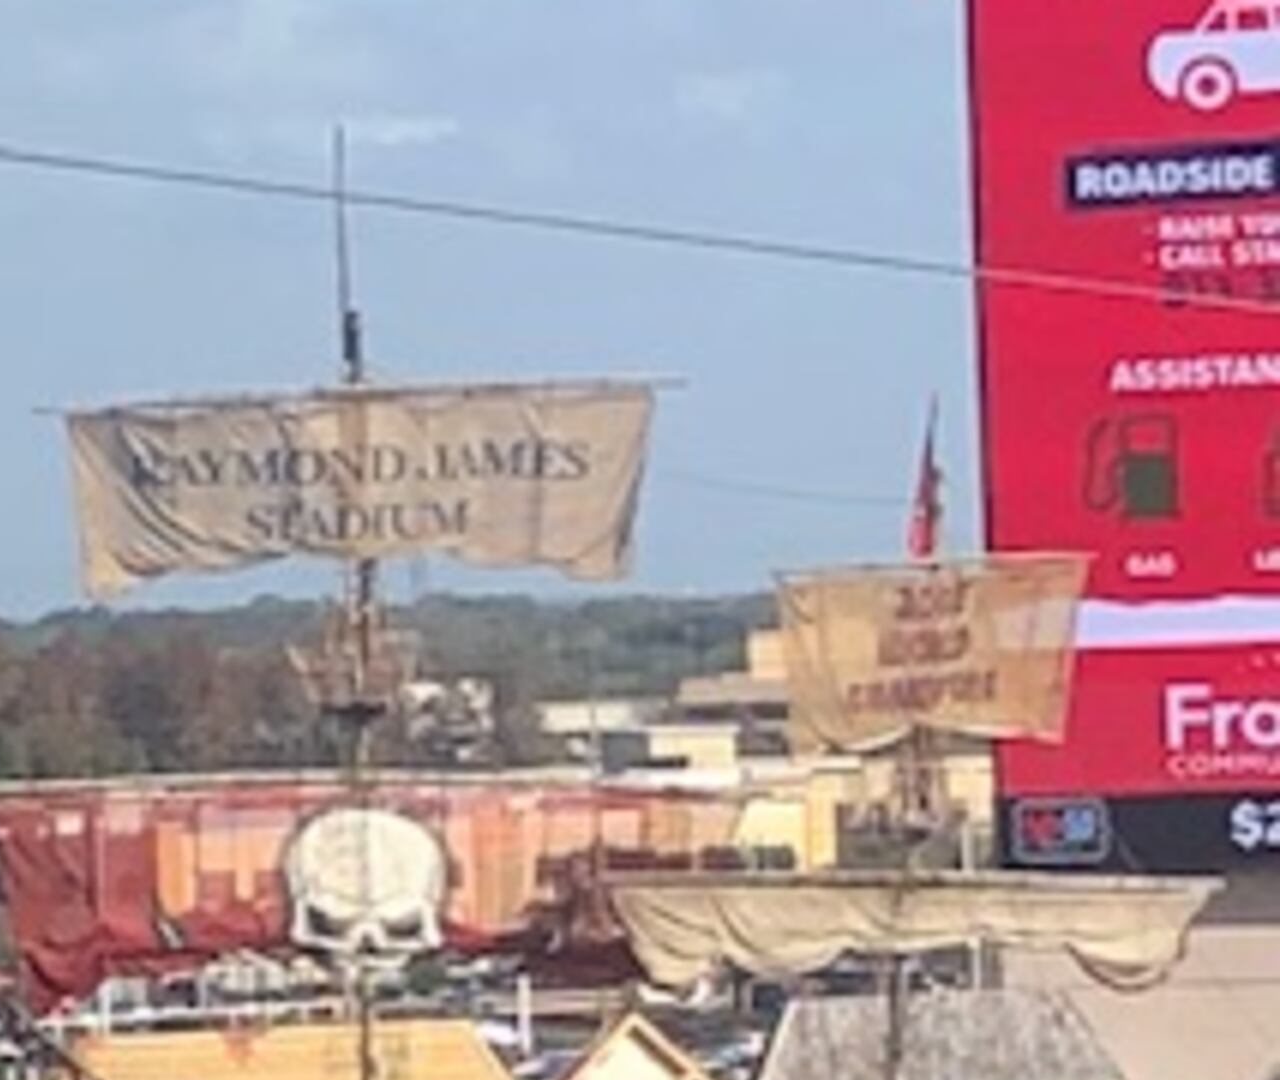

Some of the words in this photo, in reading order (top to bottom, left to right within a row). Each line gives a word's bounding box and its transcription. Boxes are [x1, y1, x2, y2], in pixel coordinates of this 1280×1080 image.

[1074, 154, 1276, 200] ROADSIDE
[130, 436, 408, 490] RAYMOND
[414, 438, 593, 488] JAMES
[243, 498, 470, 545] STADIUM
[1163, 680, 1280, 751] Fro
